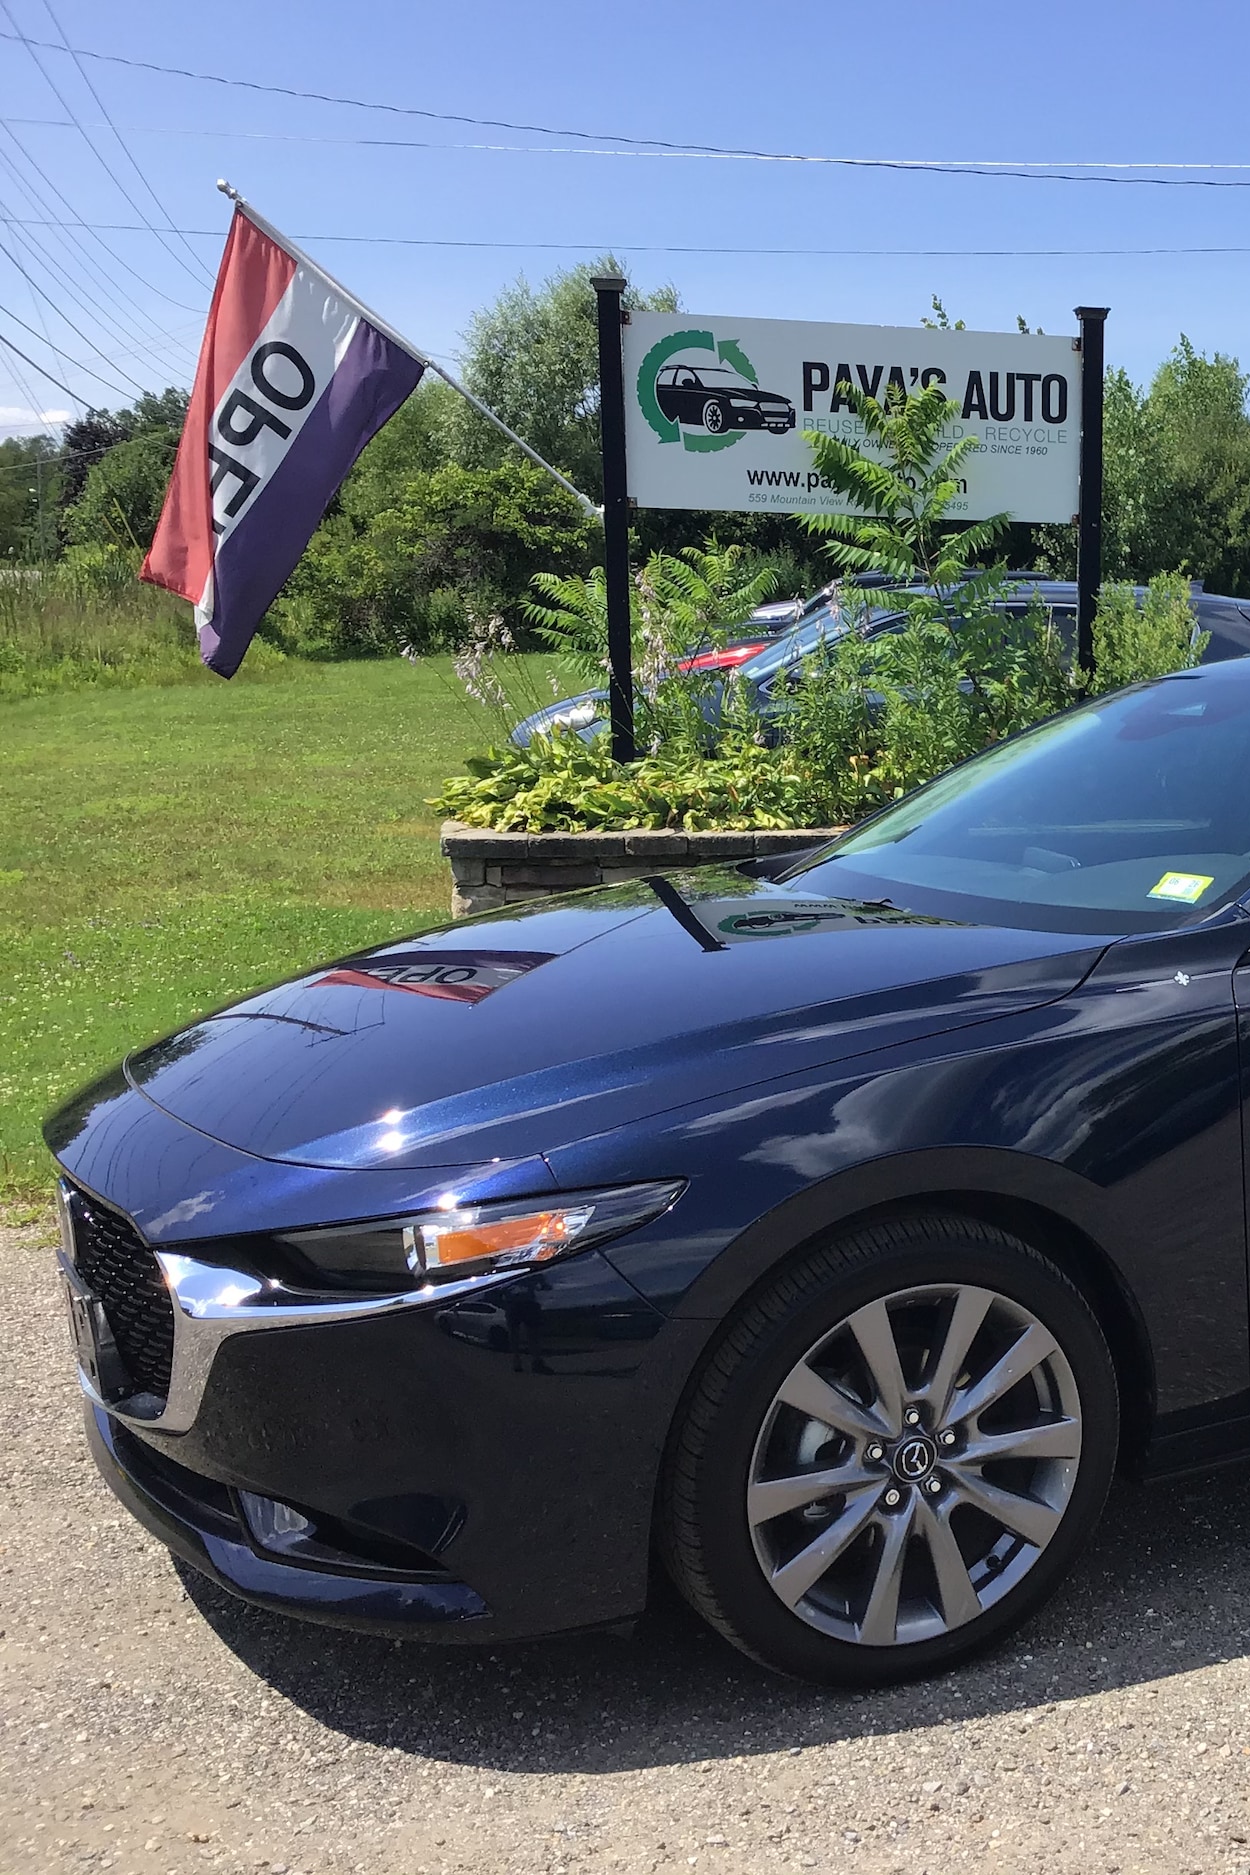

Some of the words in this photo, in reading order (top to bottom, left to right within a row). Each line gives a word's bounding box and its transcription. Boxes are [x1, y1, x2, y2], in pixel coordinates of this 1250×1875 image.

[802, 361, 947, 416] PAVA'S
[961, 370, 1067, 424] AUTO
[803, 417, 866, 435] REUSE
[985, 426, 1067, 444] RECYCLE
[862, 438, 897, 449] OWNE
[990, 444, 1022, 455] SINCE
[1025, 446, 1048, 456] 1960
[748, 493, 768, 504] 559
[770, 494, 816, 505] Mountain
[820, 496, 843, 506] View
